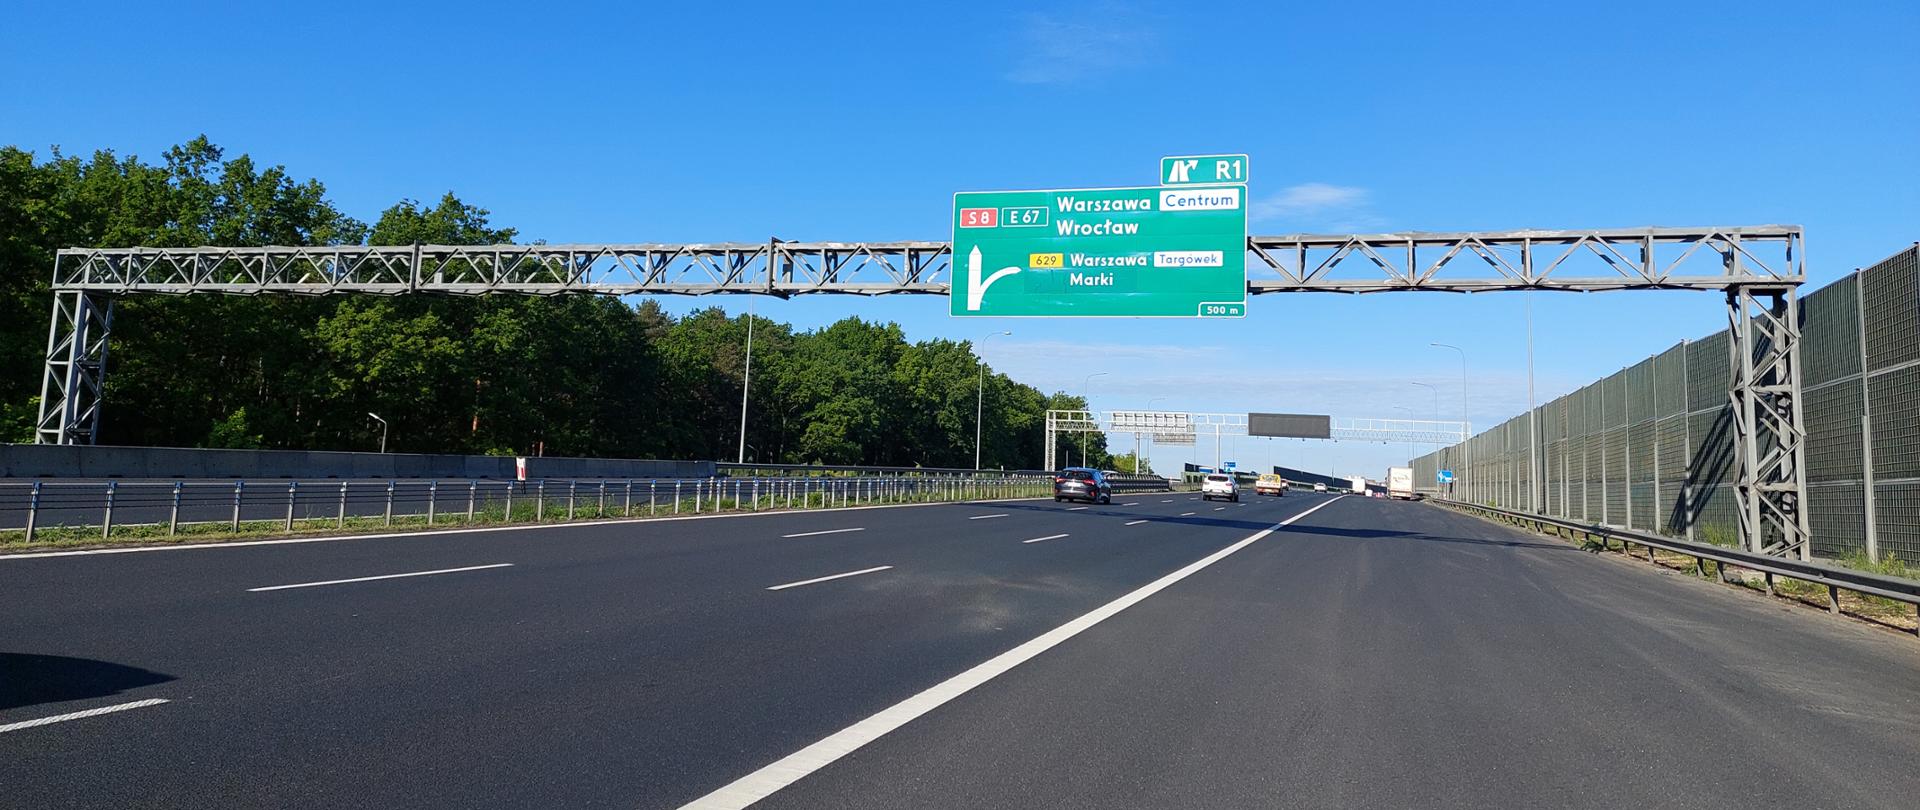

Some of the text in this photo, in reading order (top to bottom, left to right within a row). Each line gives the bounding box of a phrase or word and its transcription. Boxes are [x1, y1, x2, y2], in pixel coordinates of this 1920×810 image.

[1217, 161, 1240, 180] R1
[1057, 194, 1233, 212] Warszawa Centrum
[970, 212, 990, 225] S 8
[1011, 211, 1040, 224] E 67
[1057, 219, 1139, 236] Wrocław
[1036, 255, 1057, 266] 629
[1071, 253, 1218, 267] Warszawa Targówek
[1070, 273, 1113, 286] Marki
[1207, 306, 1226, 315] 500
